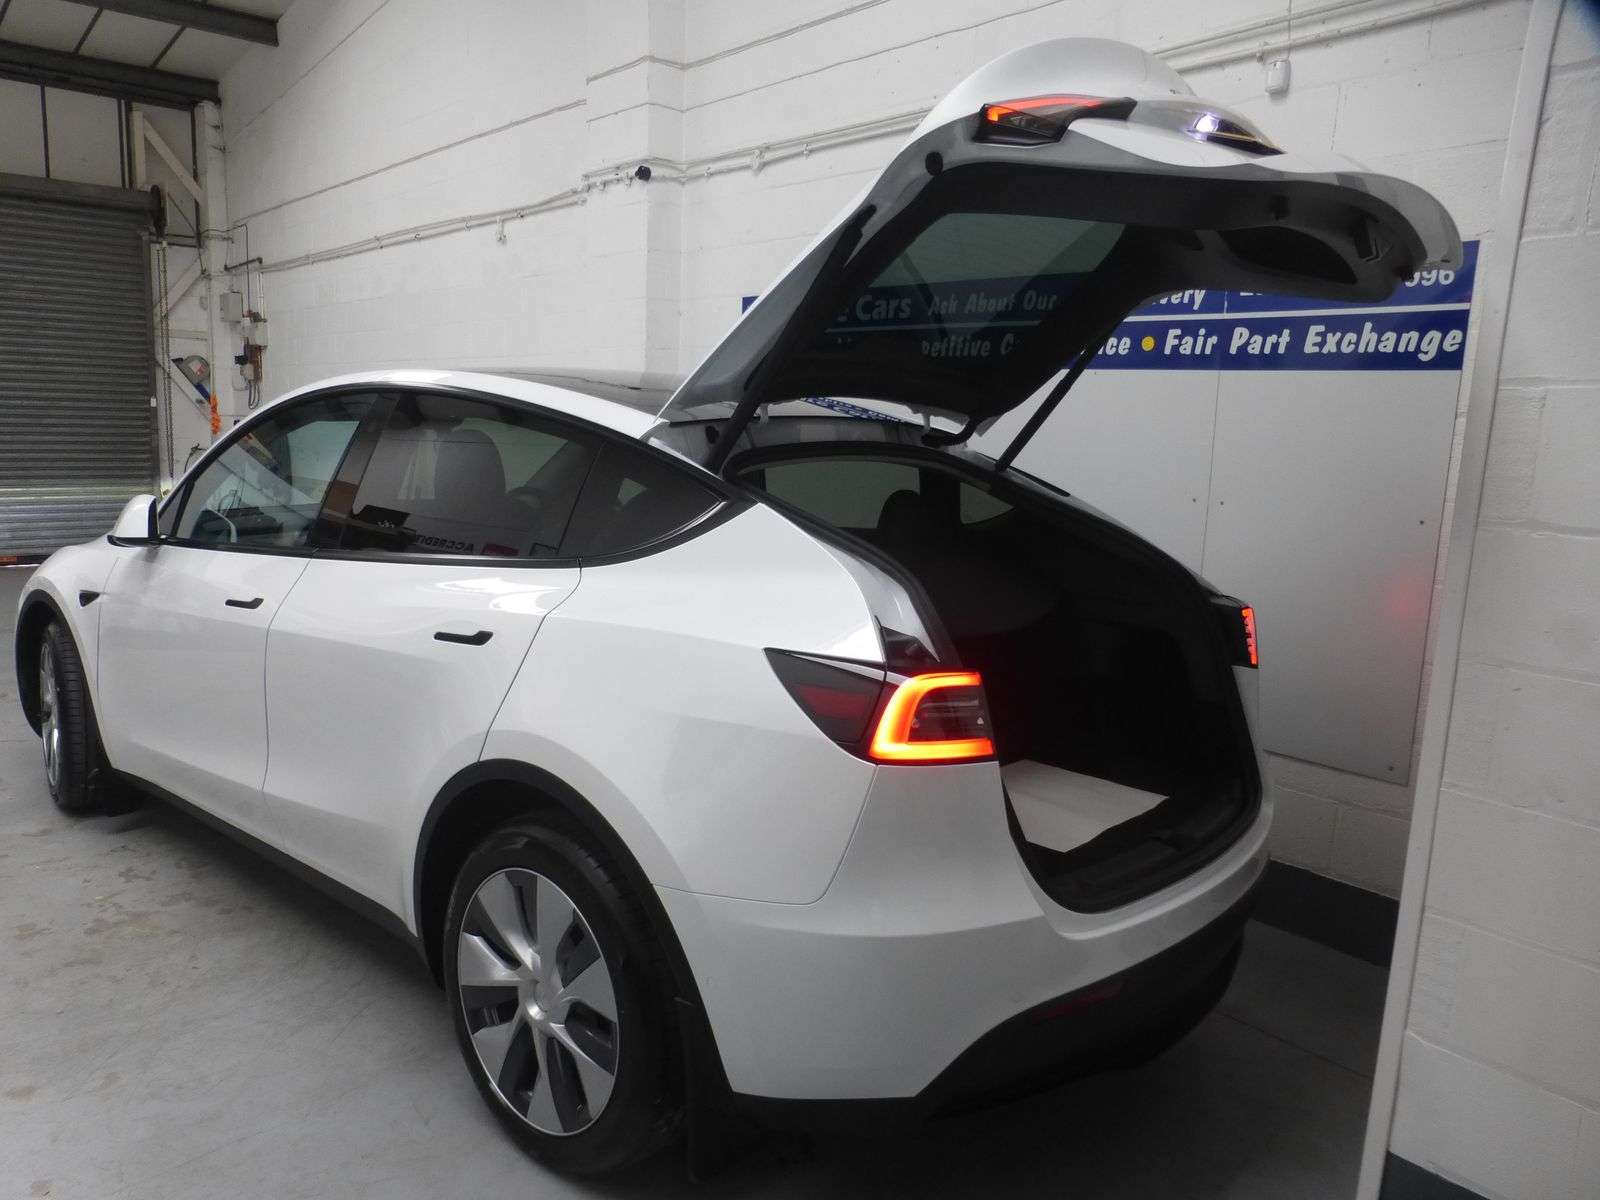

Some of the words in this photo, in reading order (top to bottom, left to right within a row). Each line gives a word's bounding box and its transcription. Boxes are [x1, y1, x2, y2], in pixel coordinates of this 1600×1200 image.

[856, 294, 912, 321] Cars
[928, 293, 959, 316] Ask
[965, 292, 1015, 314] About
[1023, 289, 1057, 311] Our
[1098, 336, 1131, 356] ce
[1164, 328, 1218, 355] Fair
[1229, 327, 1290, 355] Part
[1304, 321, 1463, 362] Exchange
